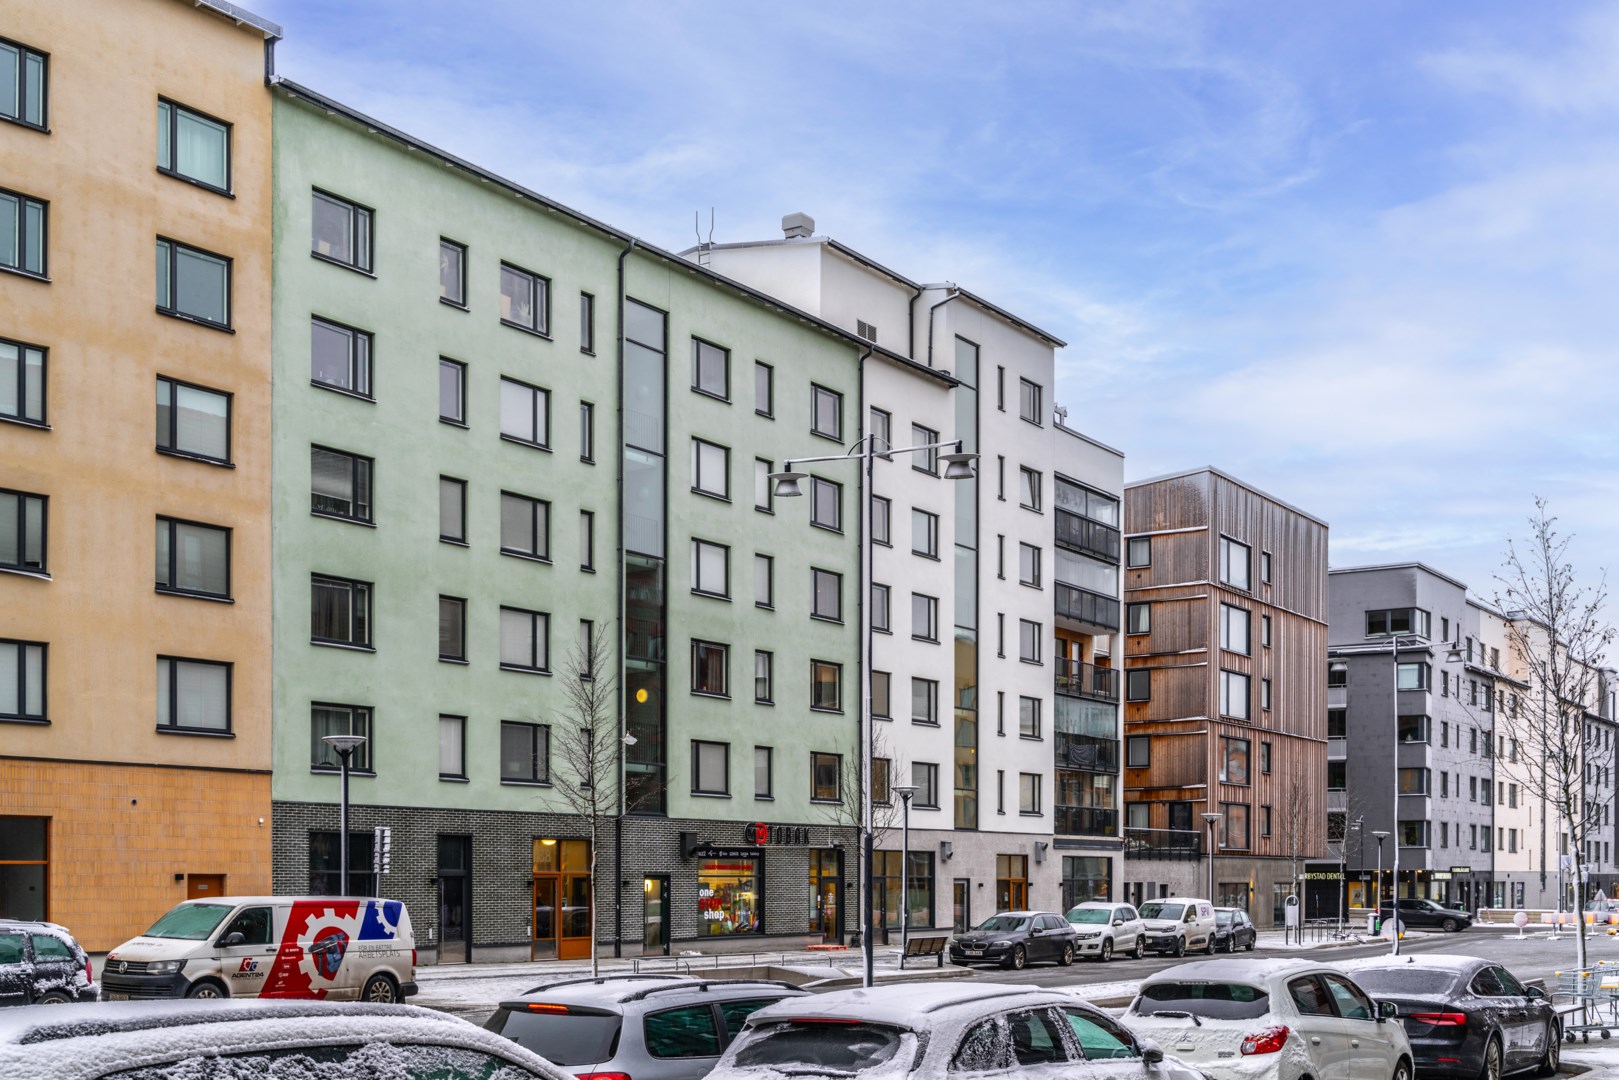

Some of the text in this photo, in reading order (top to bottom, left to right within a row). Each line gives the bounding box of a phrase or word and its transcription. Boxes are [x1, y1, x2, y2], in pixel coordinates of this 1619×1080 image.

[768, 825, 810, 845] TOBAK
[699, 889, 714, 897] one
[698, 897, 723, 910] STOP
[704, 909, 725, 921] shop
[358, 949, 401, 959] ARBETSPLATS
